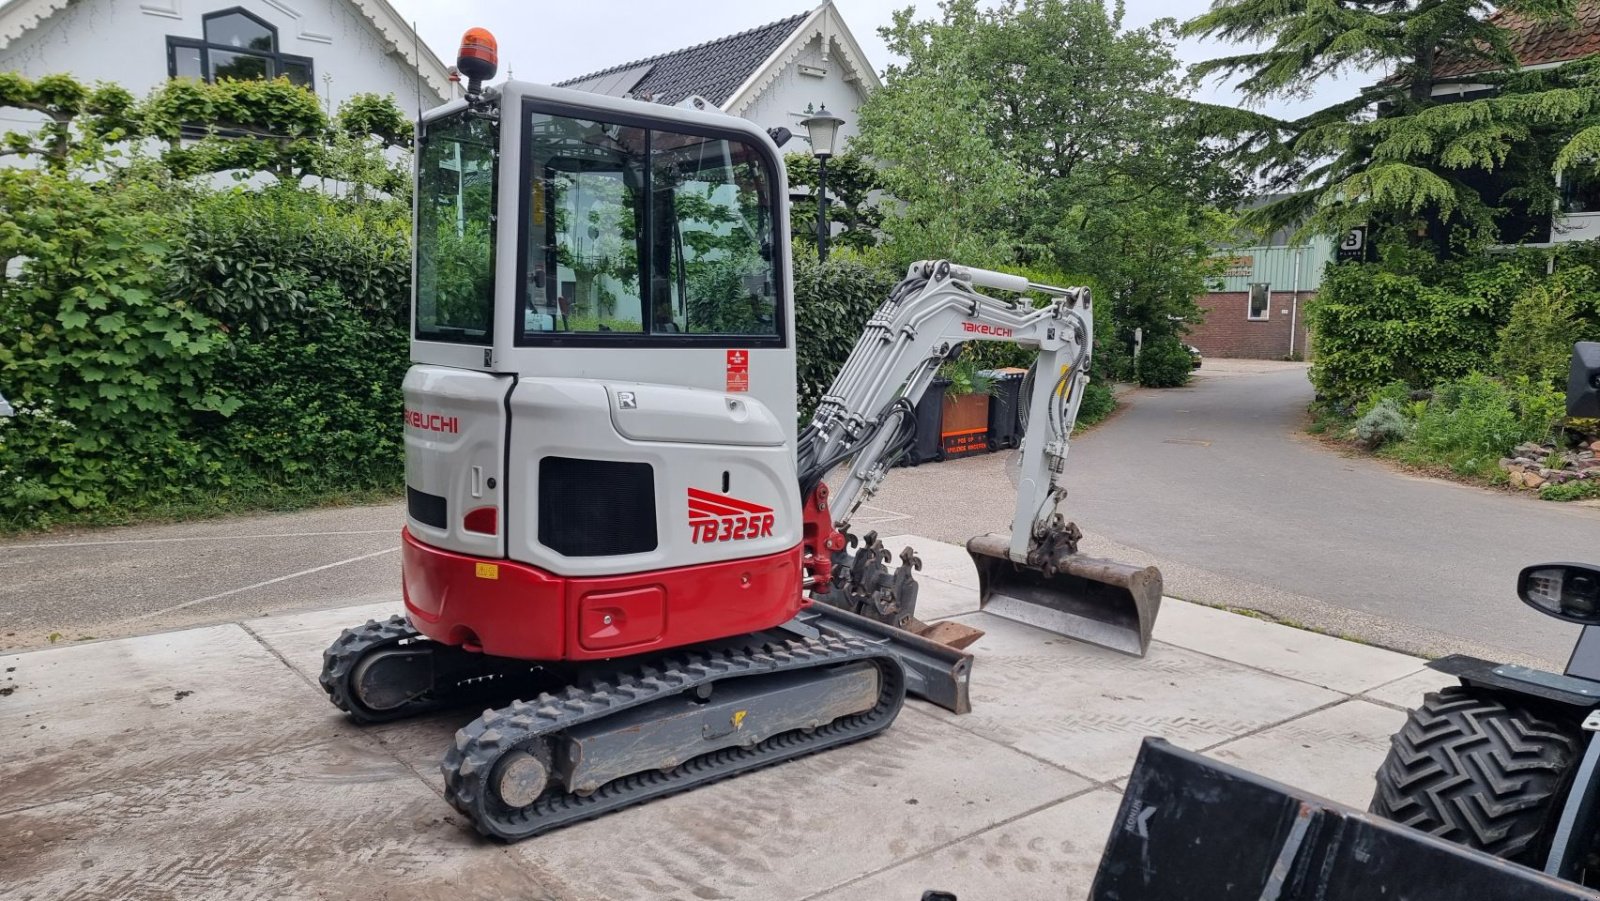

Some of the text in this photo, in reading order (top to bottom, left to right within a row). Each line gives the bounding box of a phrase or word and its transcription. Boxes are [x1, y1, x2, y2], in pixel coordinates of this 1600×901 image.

[1346, 233, 1357, 247] B
[961, 322, 1013, 338] TAKEUCHI
[619, 392, 636, 408] R
[688, 514, 775, 544] TB325R
